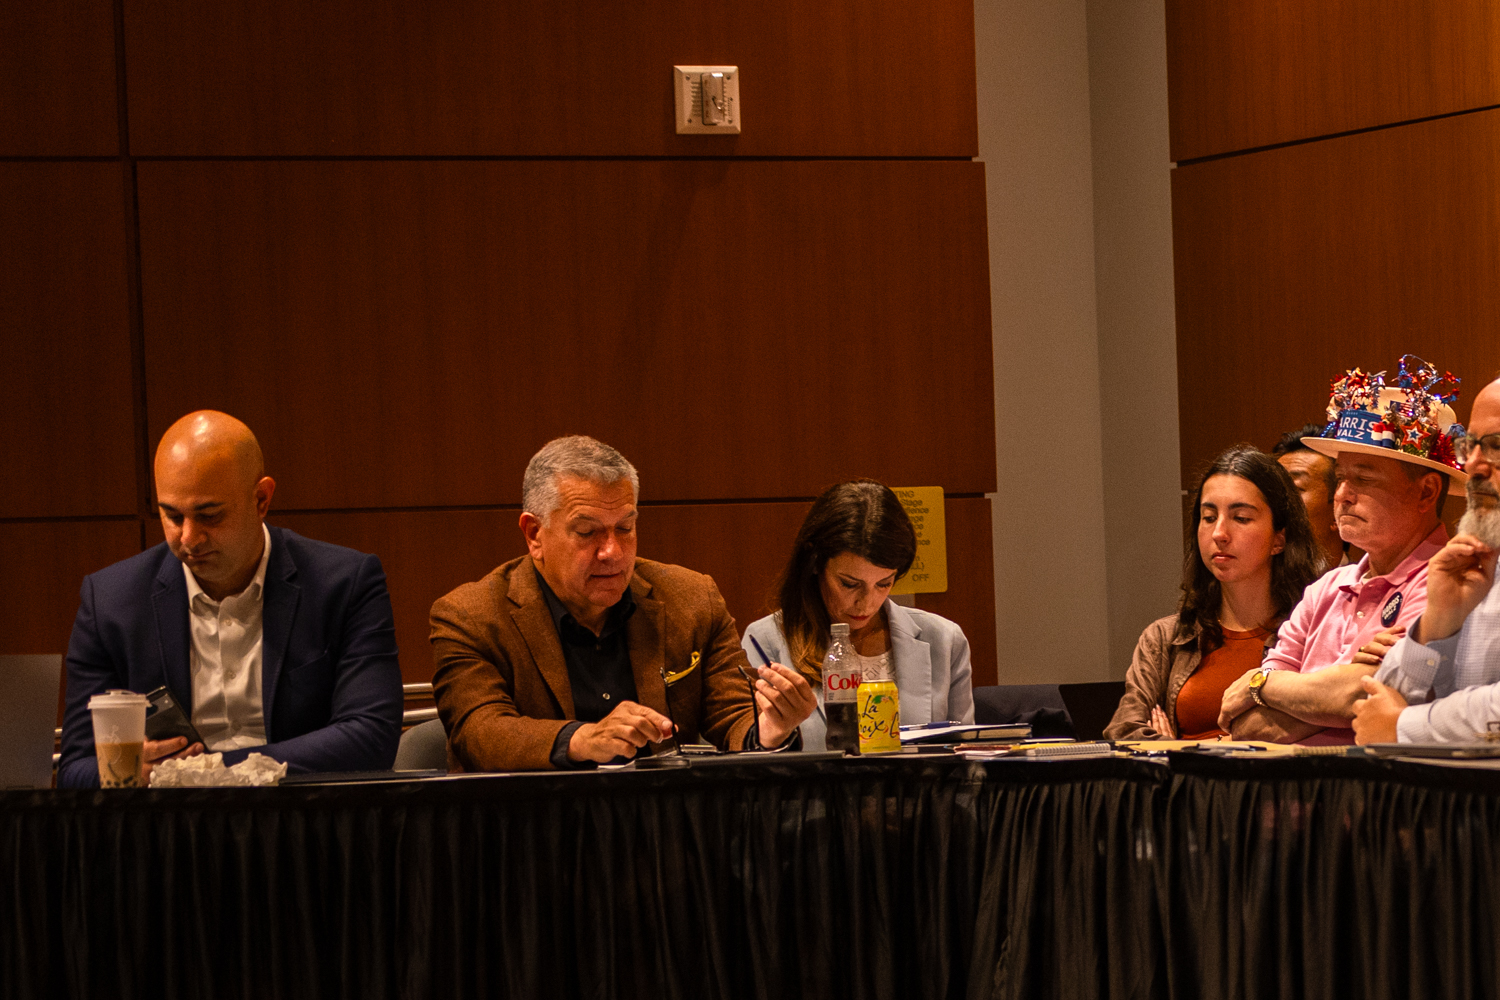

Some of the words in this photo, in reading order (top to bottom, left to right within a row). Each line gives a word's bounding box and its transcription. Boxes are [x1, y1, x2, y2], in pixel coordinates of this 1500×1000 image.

[1339, 416, 1379, 433] ARRIS
[895, 490, 914, 498] TING
[900, 499, 923, 507] Stage
[912, 573, 930, 582] OFF
[862, 694, 879, 719] La
[859, 716, 885, 738] roix
